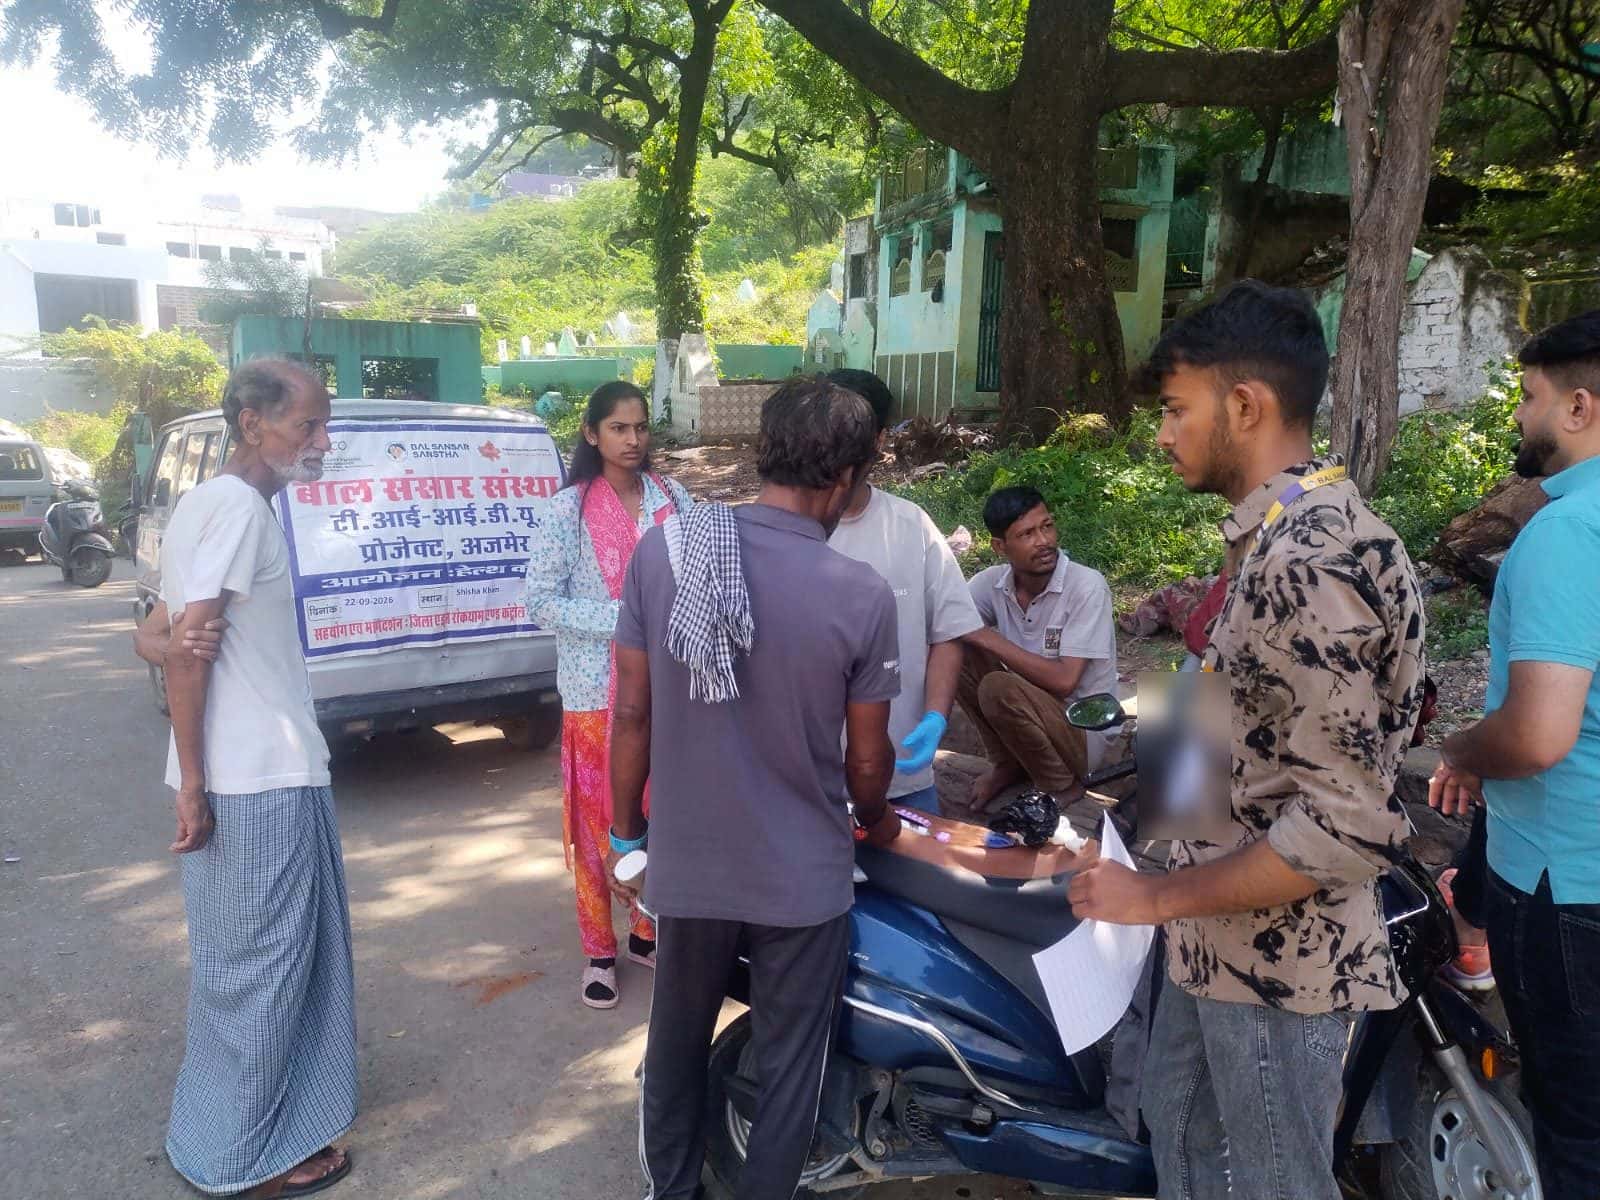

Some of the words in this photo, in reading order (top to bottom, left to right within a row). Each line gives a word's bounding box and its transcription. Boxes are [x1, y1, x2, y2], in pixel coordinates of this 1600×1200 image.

[292, 479, 374, 506] बाल
[380, 469, 474, 501] संसार
[480, 468, 559, 498] संस्था
[359, 536, 453, 563] प्रोजेक्ट,
[461, 531, 530, 555] अजमेर
[321, 570, 443, 589] आयोजन
[456, 586, 480, 595] Shisha
[482, 585, 500, 593] Khan
[345, 596, 394, 606] 22-09-2026
